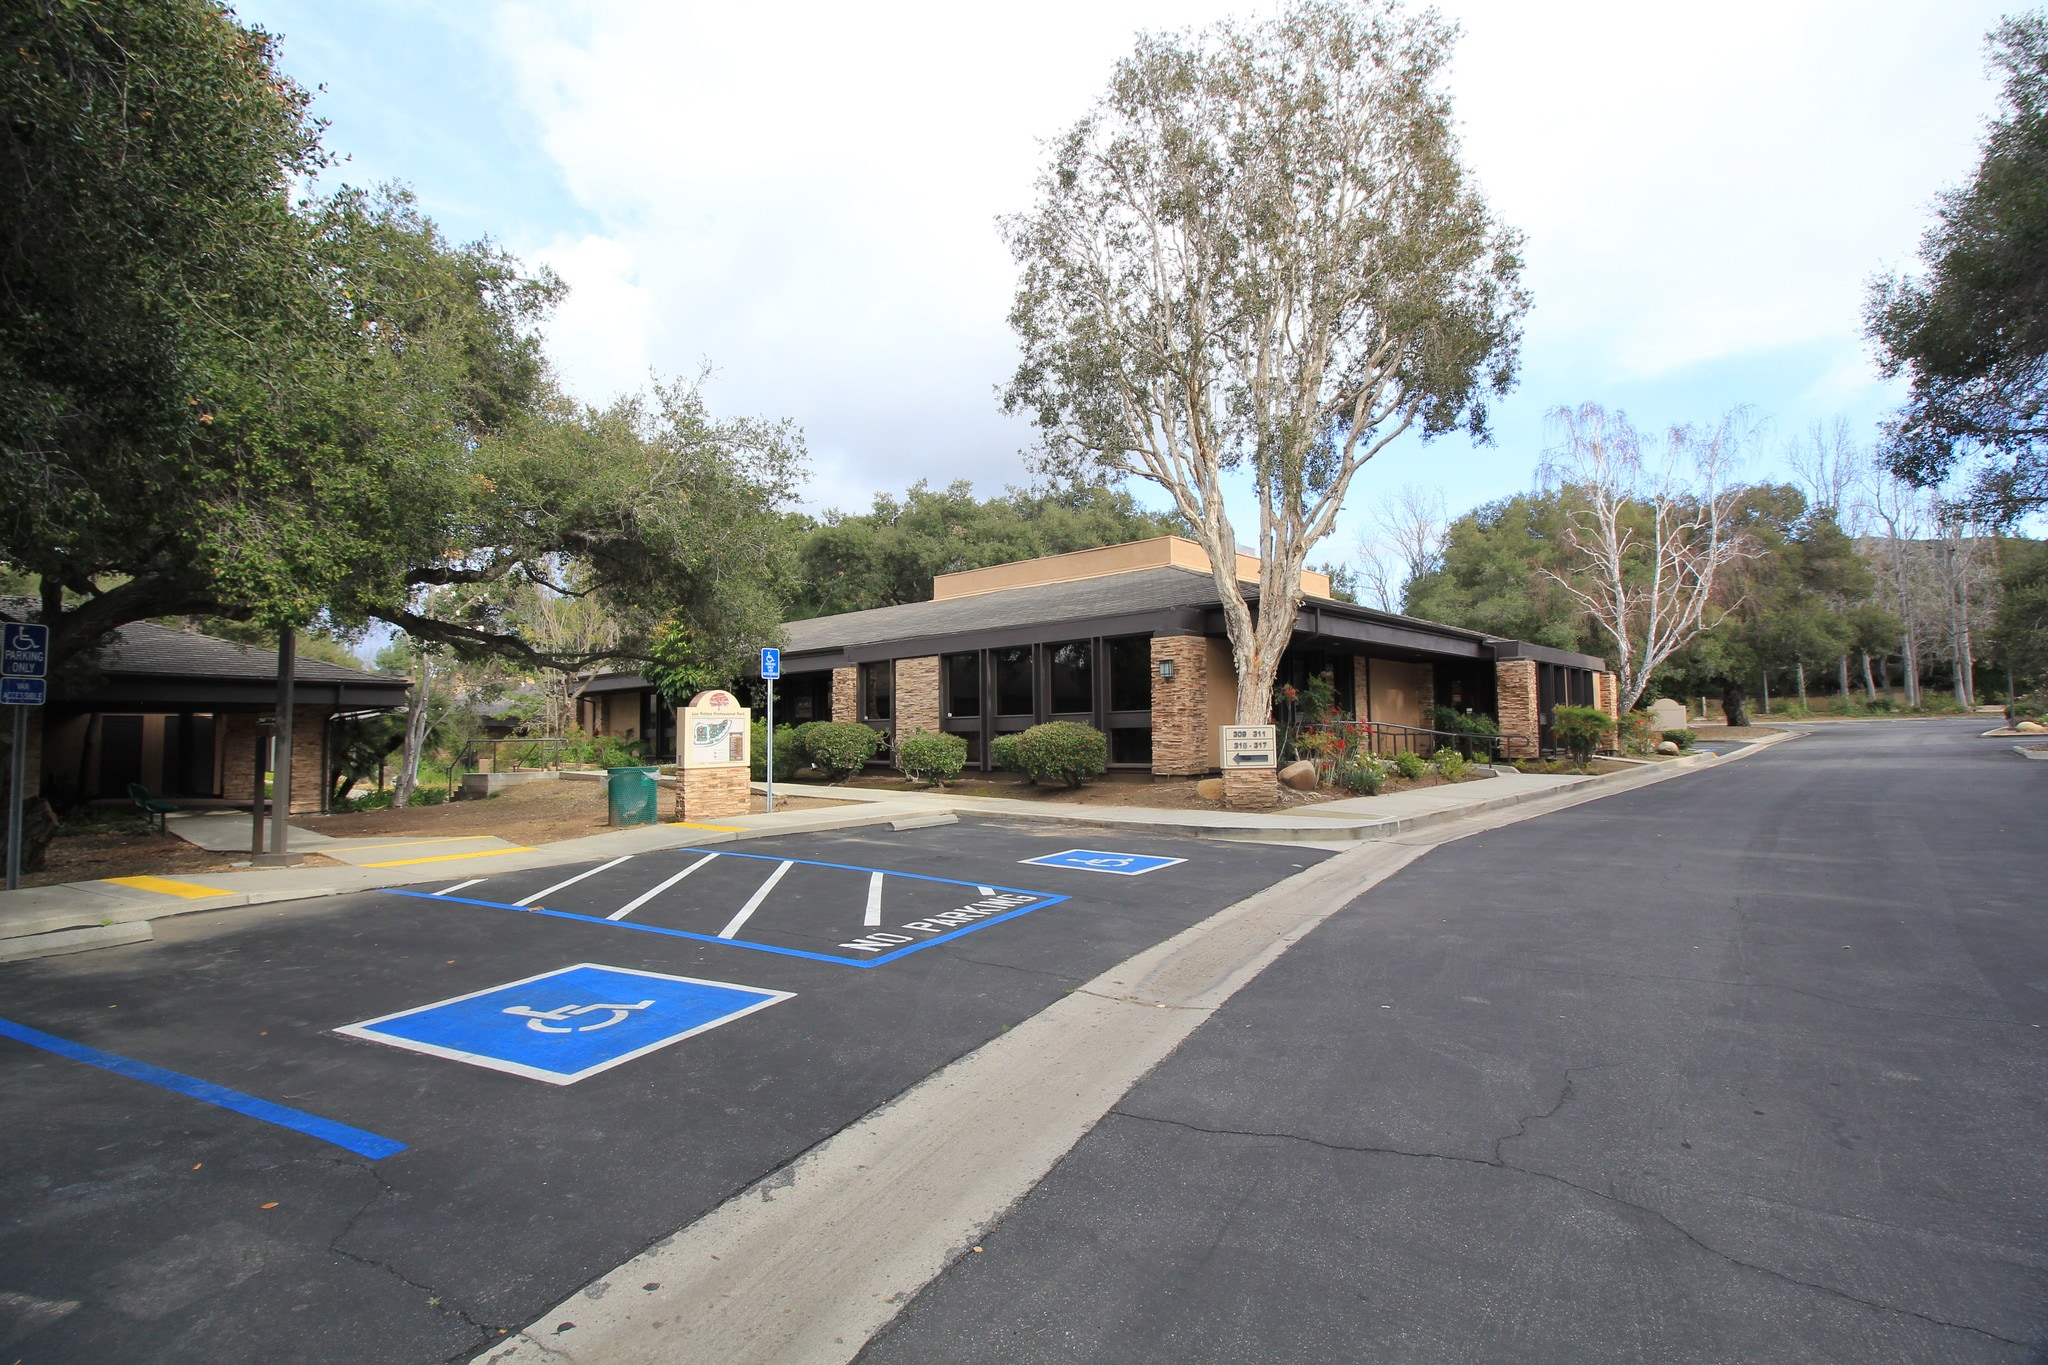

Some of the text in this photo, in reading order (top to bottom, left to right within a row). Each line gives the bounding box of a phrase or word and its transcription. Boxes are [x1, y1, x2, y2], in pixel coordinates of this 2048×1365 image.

[5, 650, 44, 662] PARKING
[12, 662, 36, 673] ONLY
[16, 682, 30, 690] VAN
[3, 691, 43, 701] ACCESSIBLE
[838, 893, 1038, 952] NO PARKING
